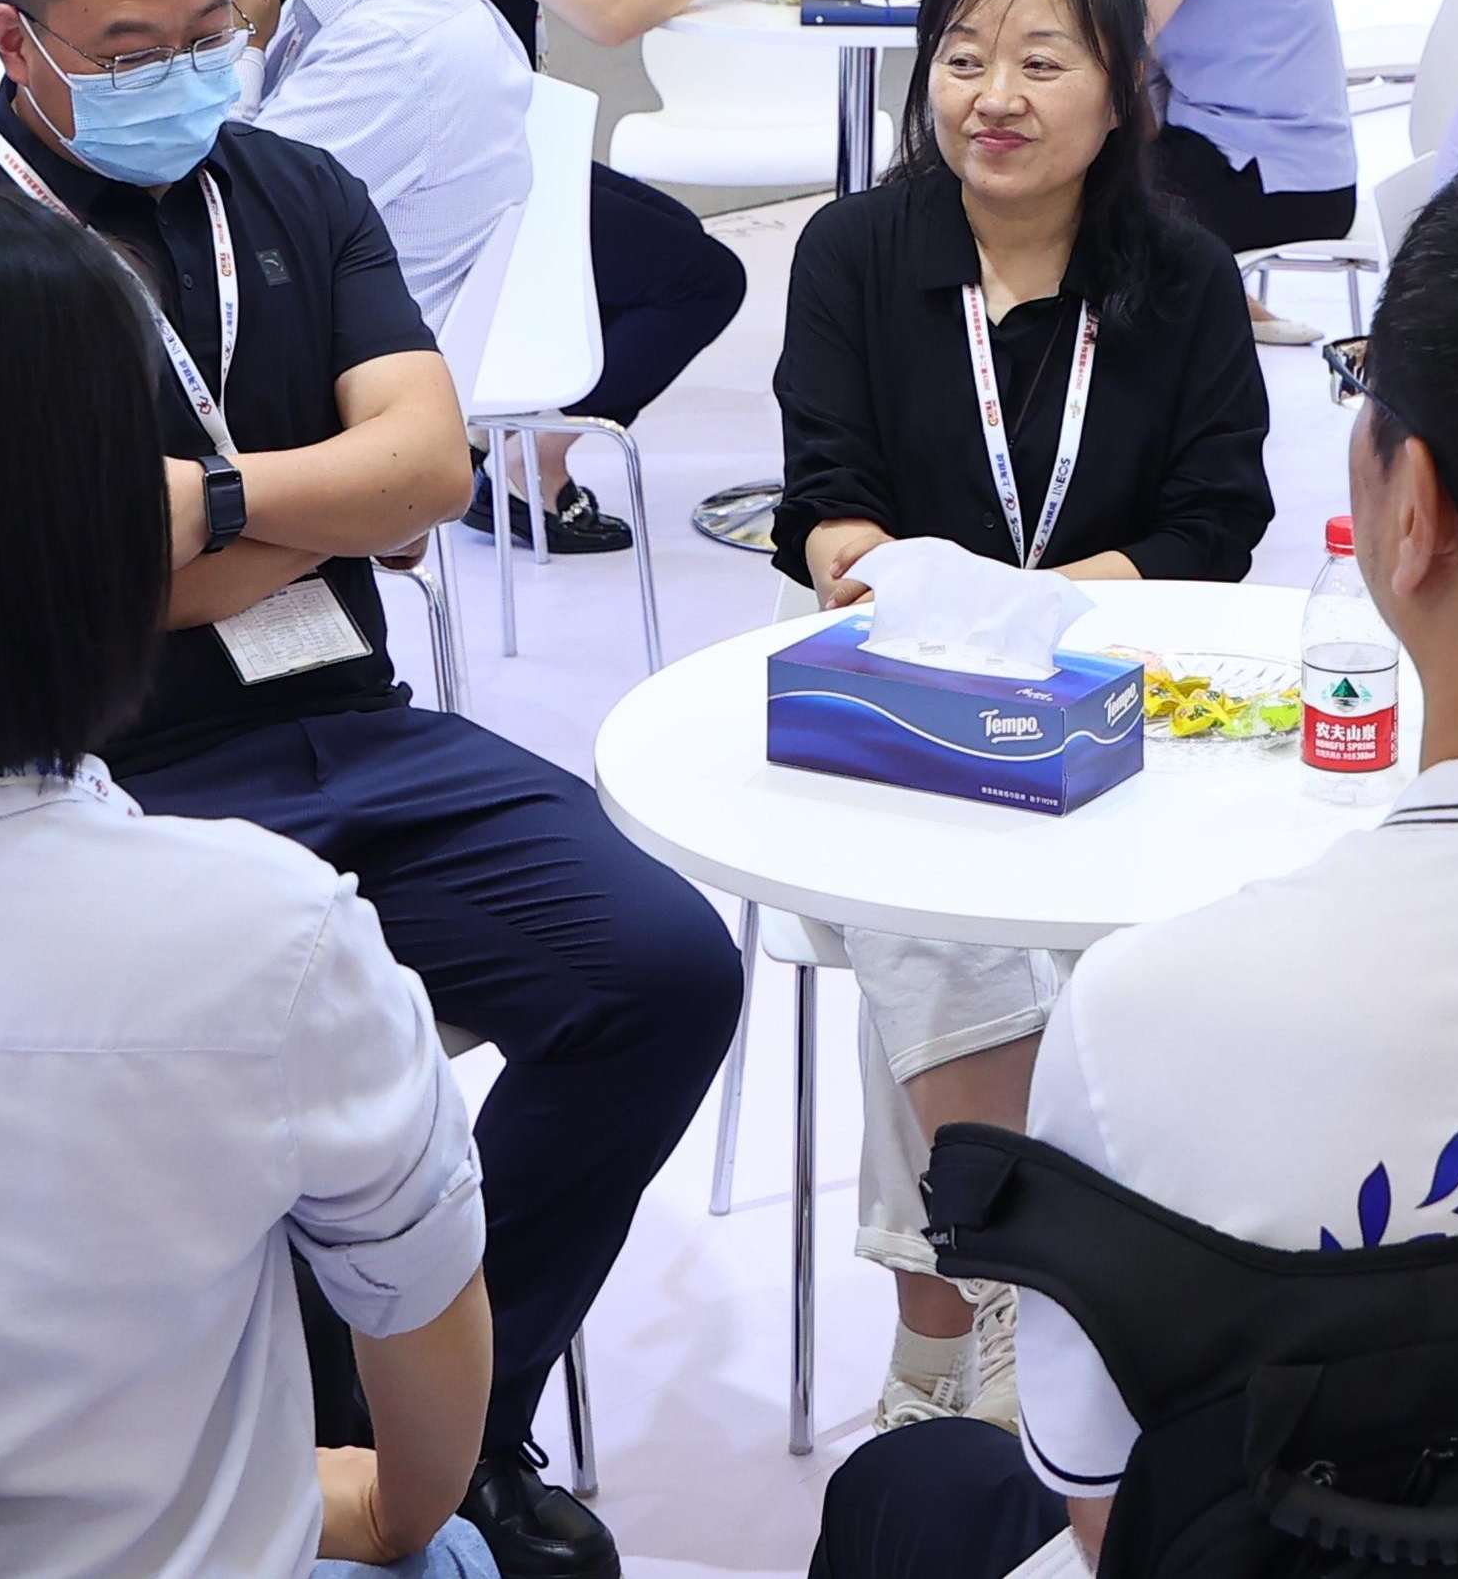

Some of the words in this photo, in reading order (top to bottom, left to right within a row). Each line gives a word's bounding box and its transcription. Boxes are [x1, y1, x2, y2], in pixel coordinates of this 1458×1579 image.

[1053, 458, 1071, 496] INEOS
[1103, 682, 1137, 724] Tempo
[979, 709, 1038, 739] Tempo
[1315, 721, 1376, 741] 农夫山泉
[1347, 741, 1376, 751] SPRING
